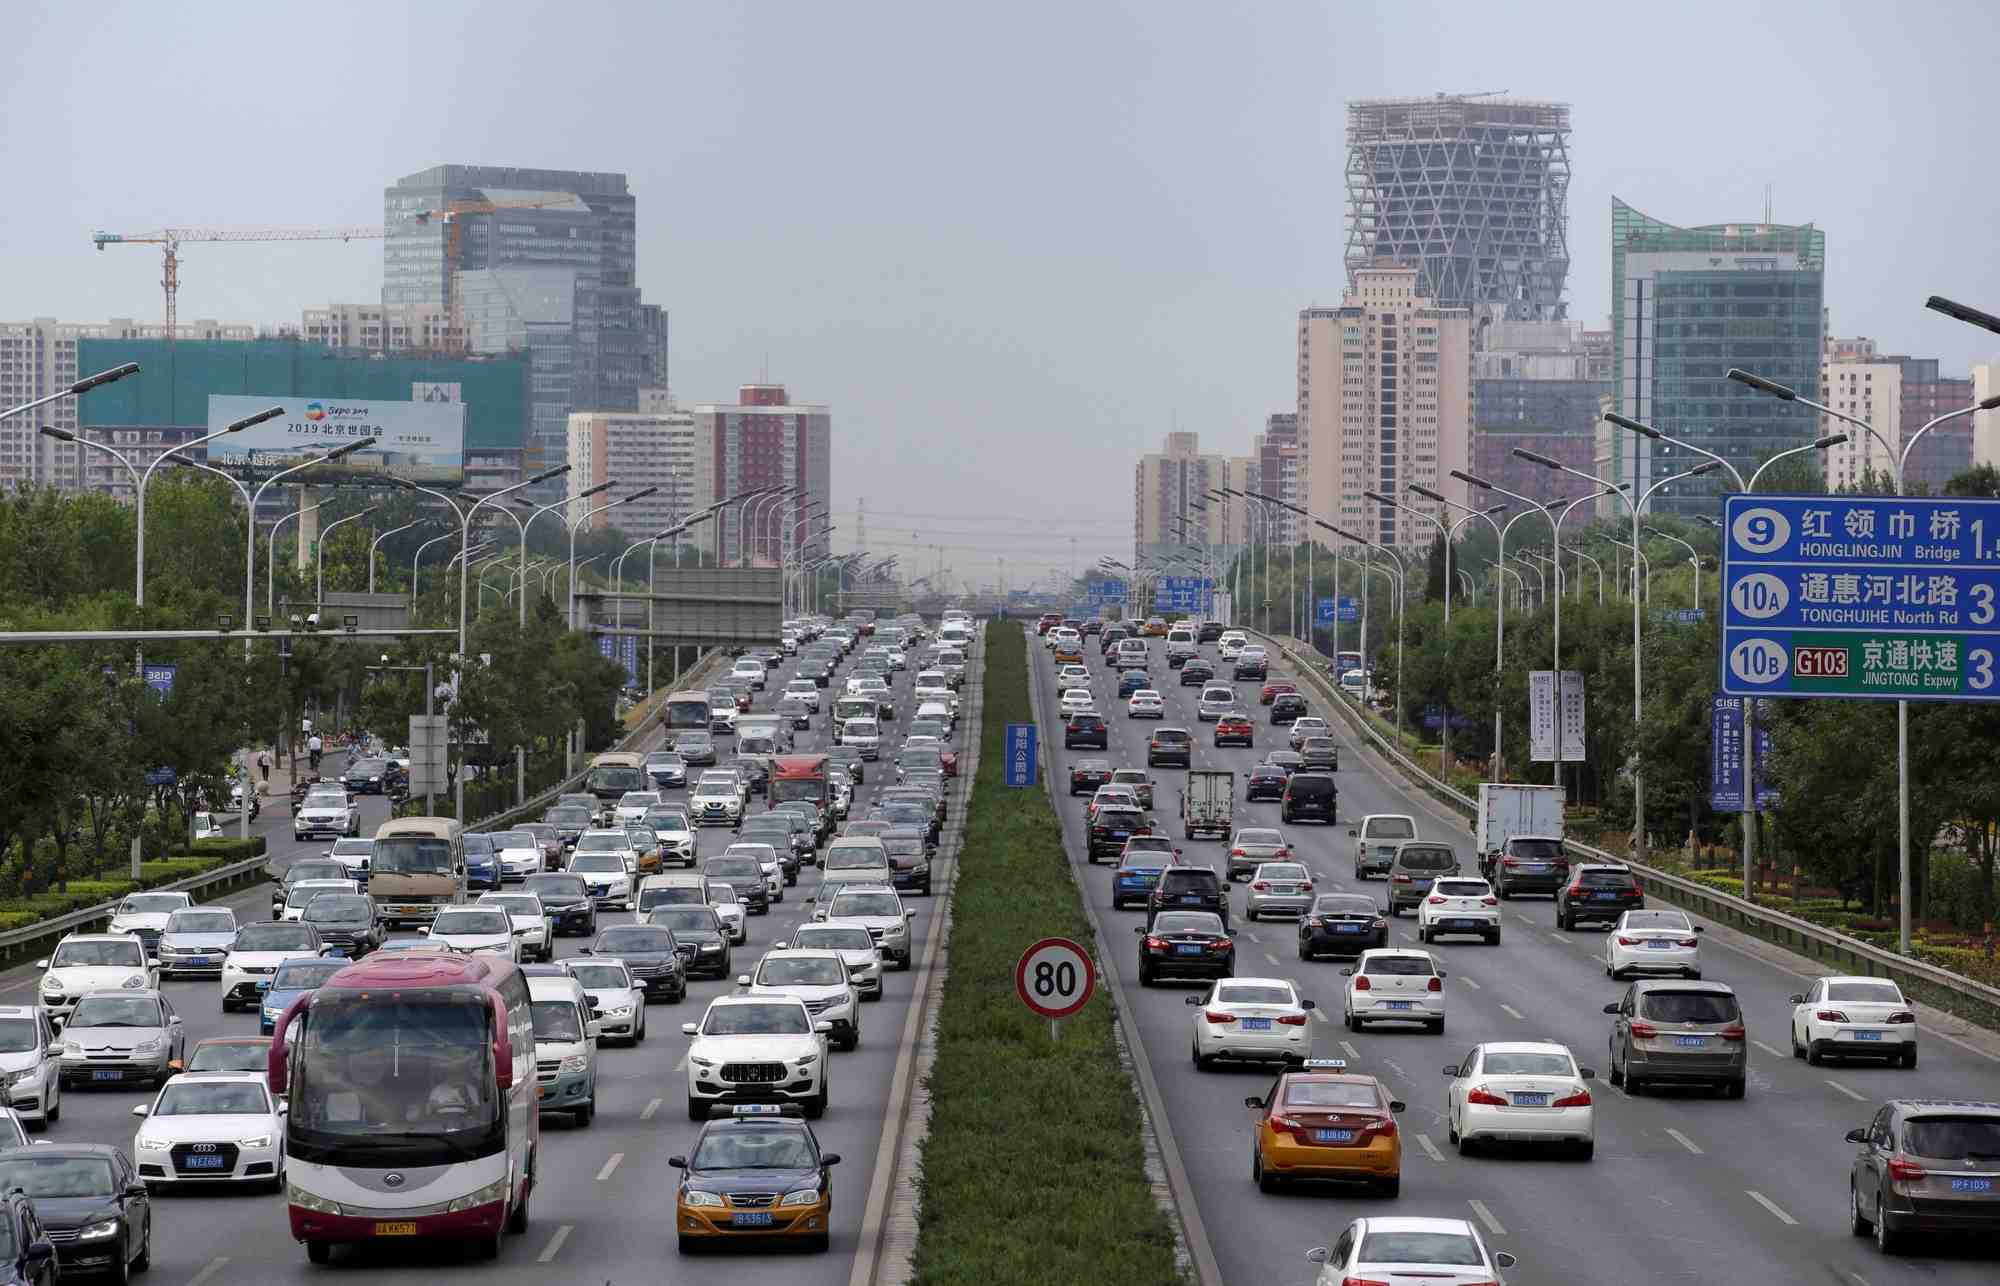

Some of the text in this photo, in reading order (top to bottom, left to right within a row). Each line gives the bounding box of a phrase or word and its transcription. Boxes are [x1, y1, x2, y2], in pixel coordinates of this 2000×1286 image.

[287, 423, 384, 436] 2019 北京世园会
[1747, 516, 1776, 546] 9
[1801, 509, 1961, 540] 红领巾桥
[1800, 543, 1961, 561] HONGLINGJIN Bridge
[1970, 520, 2000, 560] 1.
[1739, 581, 1780, 611] 10A
[1800, 573, 1959, 606] 通惠河北路
[1969, 584, 1995, 624] 3
[1800, 608, 1958, 624] TONGHUIHE North Rd
[1739, 646, 1779, 676] 10B
[1797, 650, 1847, 674] G103
[1862, 640, 1958, 671] 京通快速
[1968, 649, 1994, 689] 3
[1862, 671, 1958, 688] JINGTONG Expwy
[1035, 961, 1076, 996] 80
